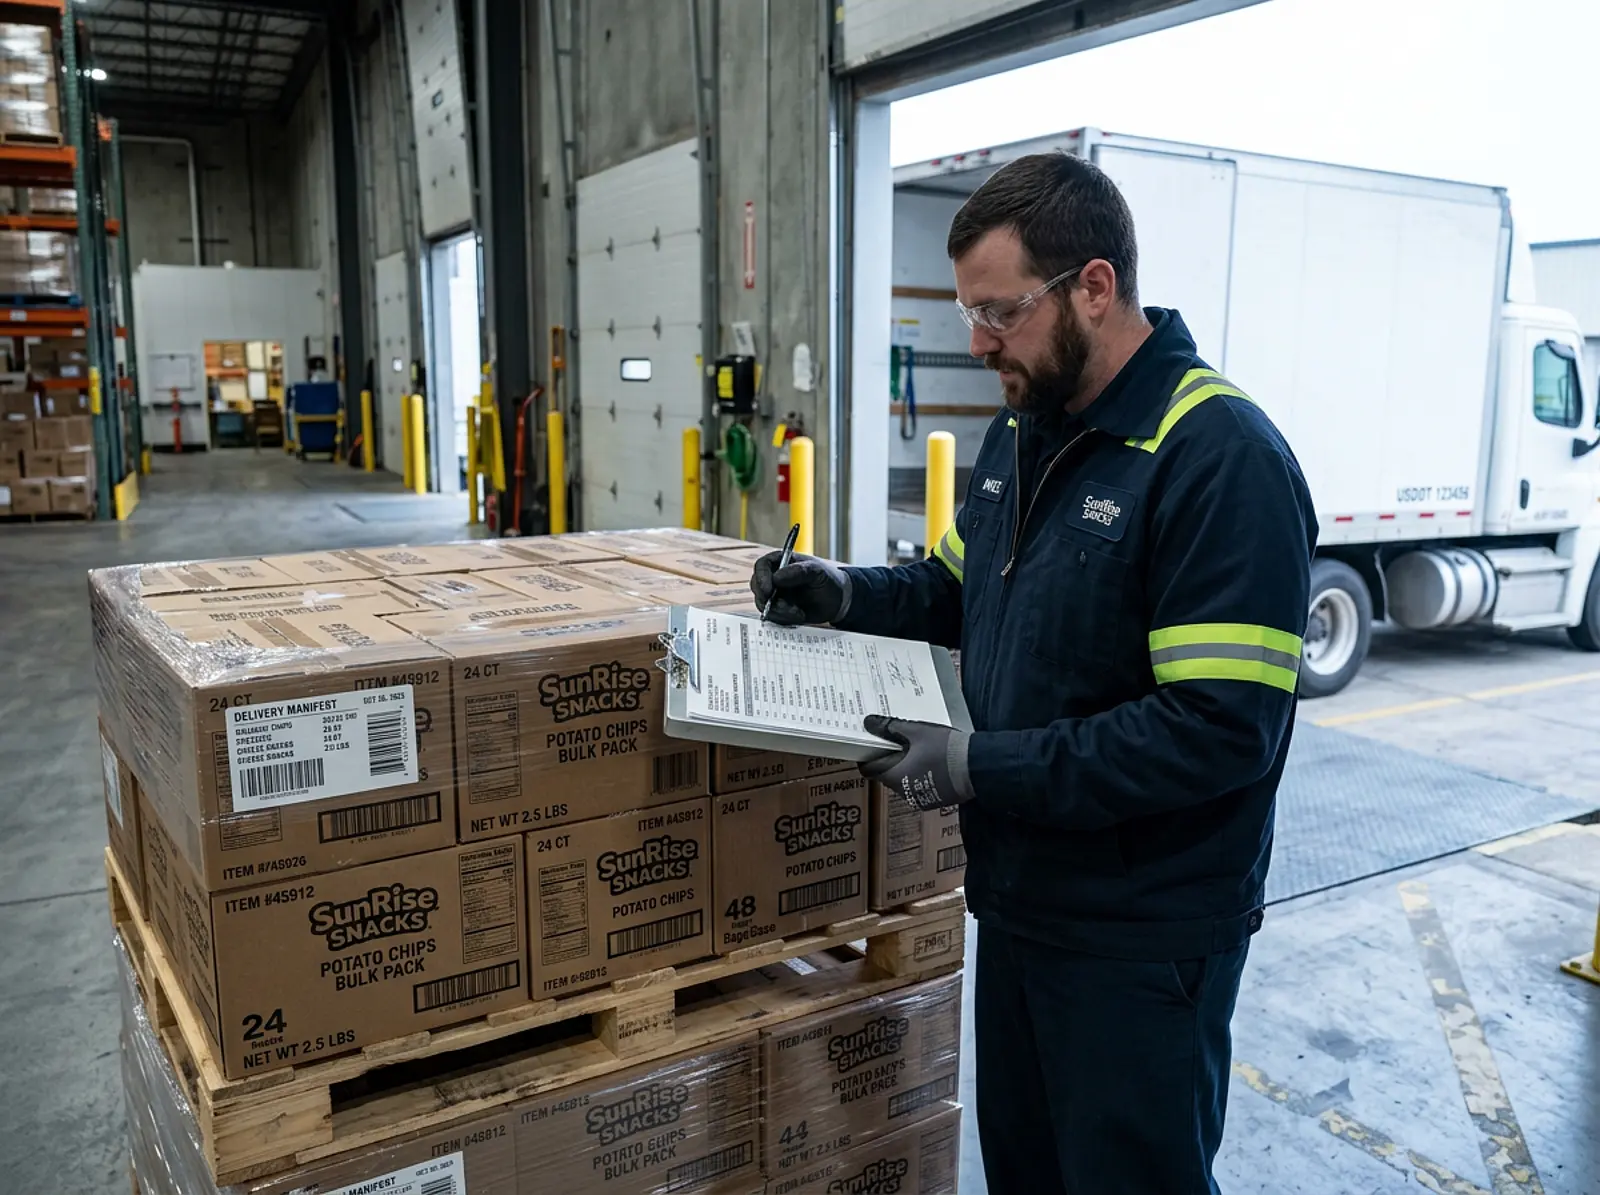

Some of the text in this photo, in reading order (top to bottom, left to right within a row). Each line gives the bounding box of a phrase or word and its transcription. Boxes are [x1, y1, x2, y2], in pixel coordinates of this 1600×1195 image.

[1397, 487, 1432, 502] USDOT
[464, 663, 500, 679] 24 CT
[541, 663, 648, 704] SunRise
[209, 693, 252, 712] 24 CT
[234, 699, 337, 722] DELIVERY MANIFEST
[555, 690, 638, 719] SNACKS
[546, 720, 648, 749] POTATO CHIPS
[558, 739, 638, 763] BULK PACK
[471, 804, 568, 833] NET WT 2.5 LBS
[722, 799, 751, 815] 24 CT
[638, 818, 665, 832] ITEM
[777, 803, 861, 841] SunRise
[537, 835, 571, 852] 24 CT
[787, 824, 852, 853] SNACKS
[223, 864, 254, 880] ITEM
[599, 836, 698, 879] SunRise
[785, 851, 857, 878] POTATO CHIPS
[611, 861, 688, 893] SNACKS
[224, 895, 261, 913] ITEM
[312, 885, 437, 932] SunRise
[612, 888, 695, 919] POTATO CHIPS
[724, 895, 757, 920] 48
[329, 911, 427, 950] SNACKS
[320, 938, 437, 978] POTATO CHIPS
[335, 957, 426, 992] BULK PACK
[543, 974, 569, 991] ITEM
[242, 1008, 288, 1042] 24
[829, 1018, 909, 1060] SunRise
[243, 1051, 272, 1069] NET
[275, 1044, 299, 1063] WT
[302, 1037, 325, 1054] 2.5
[328, 1029, 355, 1047] LBS
[520, 1108, 549, 1124] ITEM
[588, 1085, 688, 1132] SunRise
[599, 1107, 681, 1145] SNACKS
[593, 1142, 644, 1170] POTATO
[604, 1145, 678, 1181] BULK PACK
[348, 1175, 397, 1195] MANIFEST
